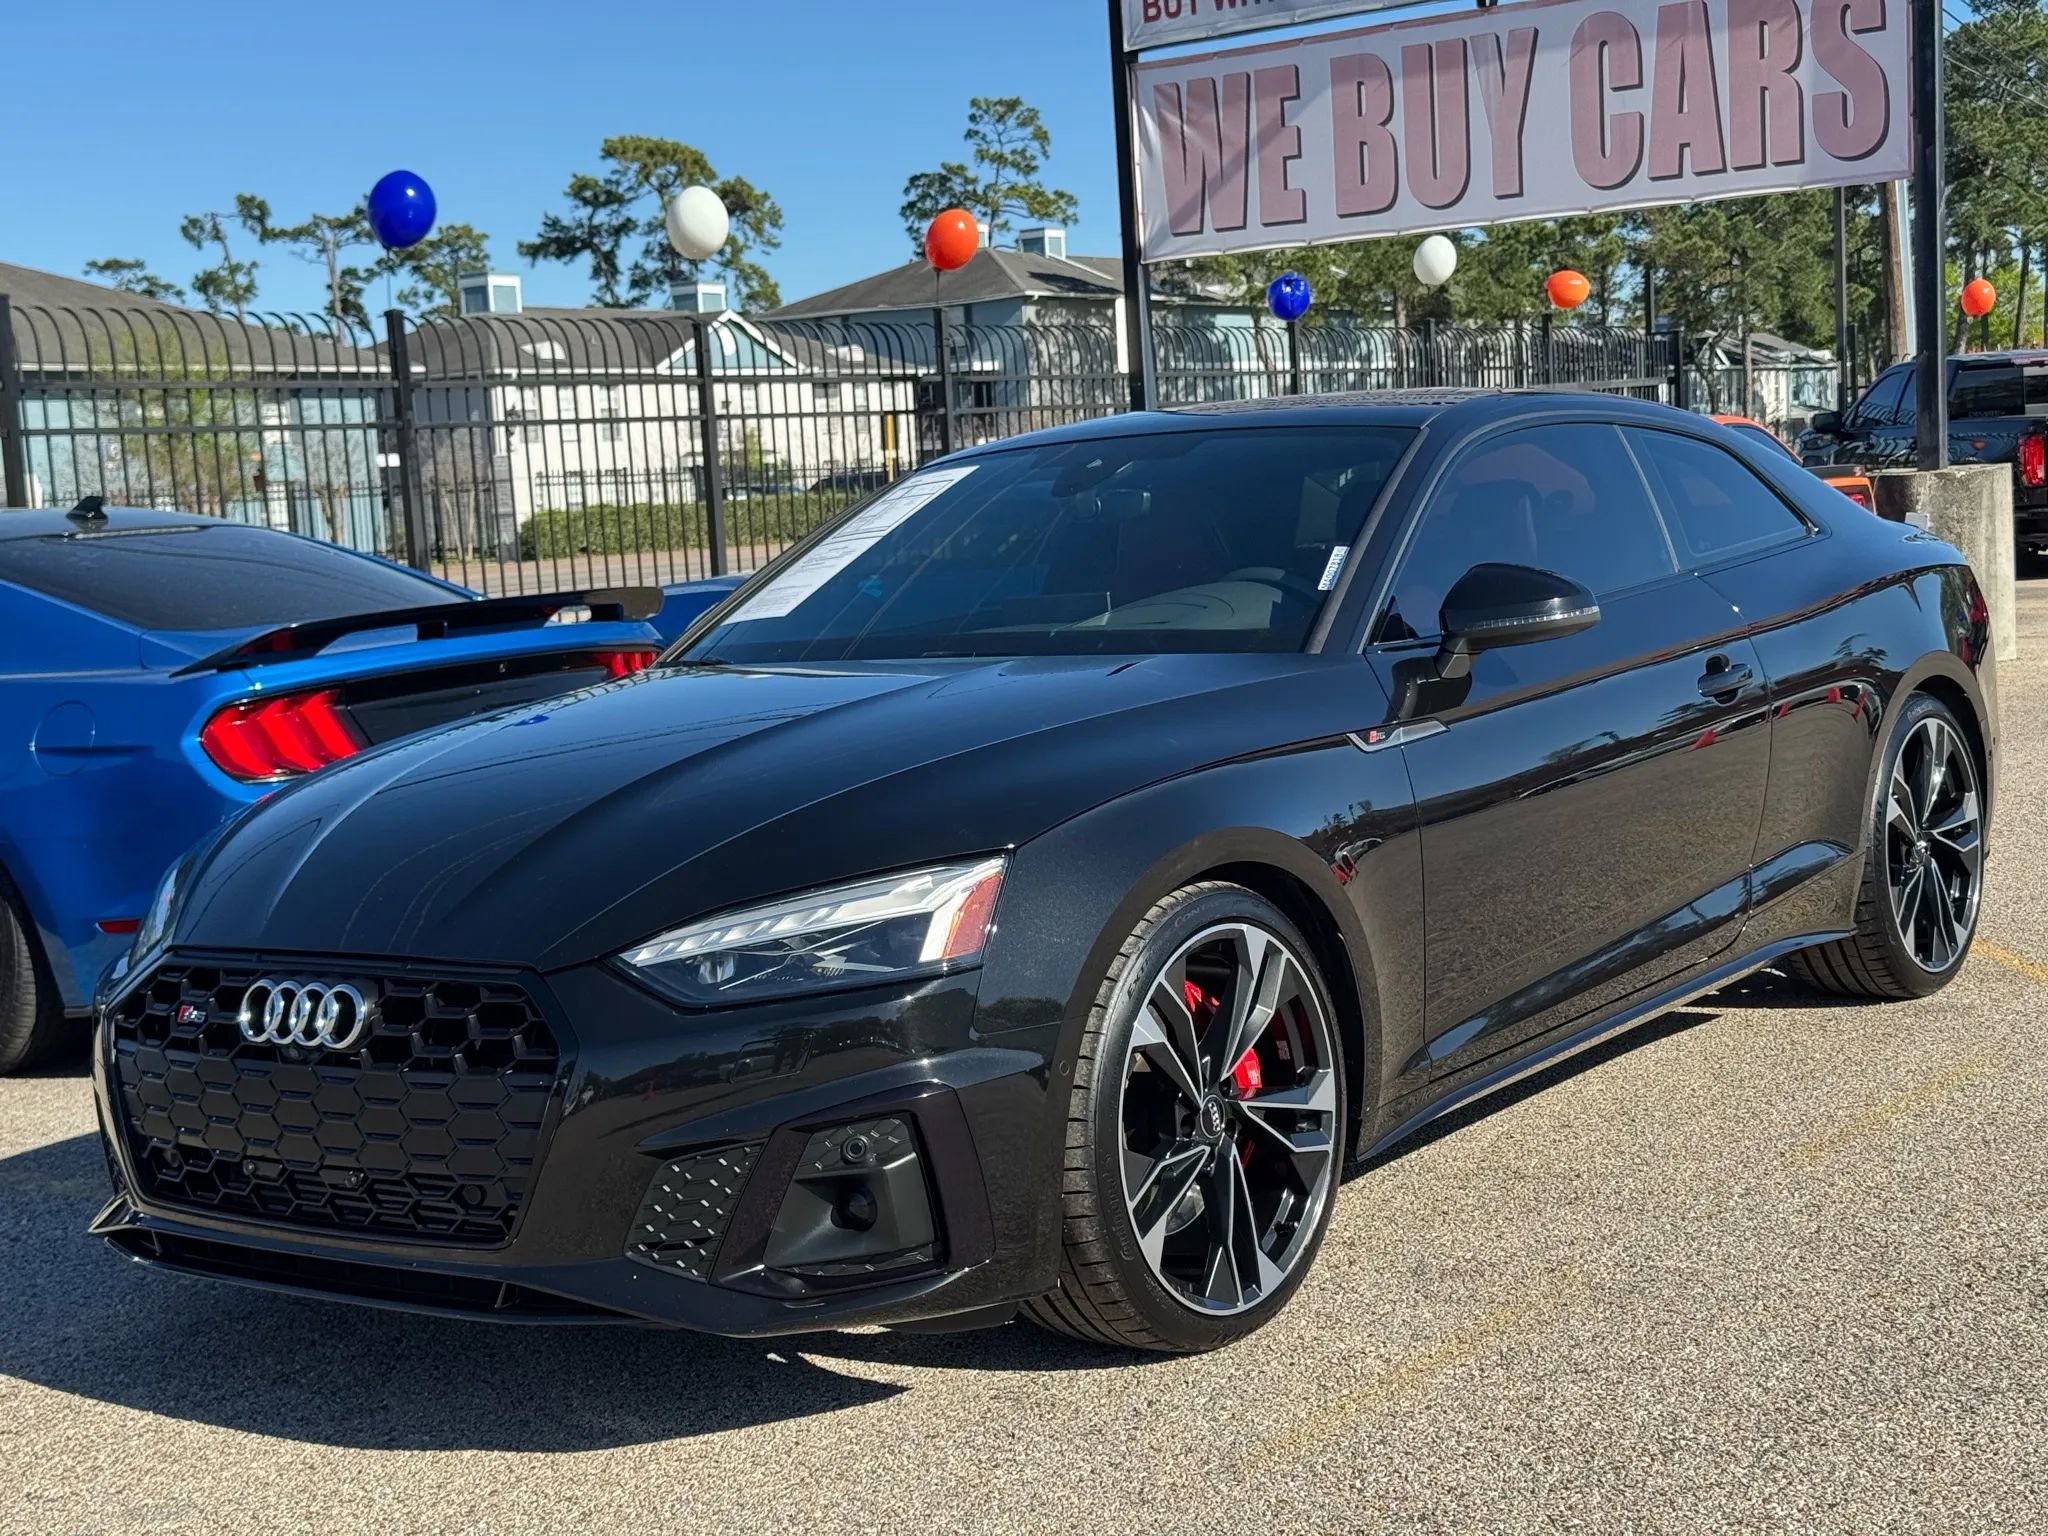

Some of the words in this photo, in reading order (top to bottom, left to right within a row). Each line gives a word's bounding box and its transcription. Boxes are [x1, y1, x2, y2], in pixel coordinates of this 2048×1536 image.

[1153, 64, 1307, 237] WE
[1330, 27, 1539, 218] BUY
[1569, 0, 1889, 191] CARS
